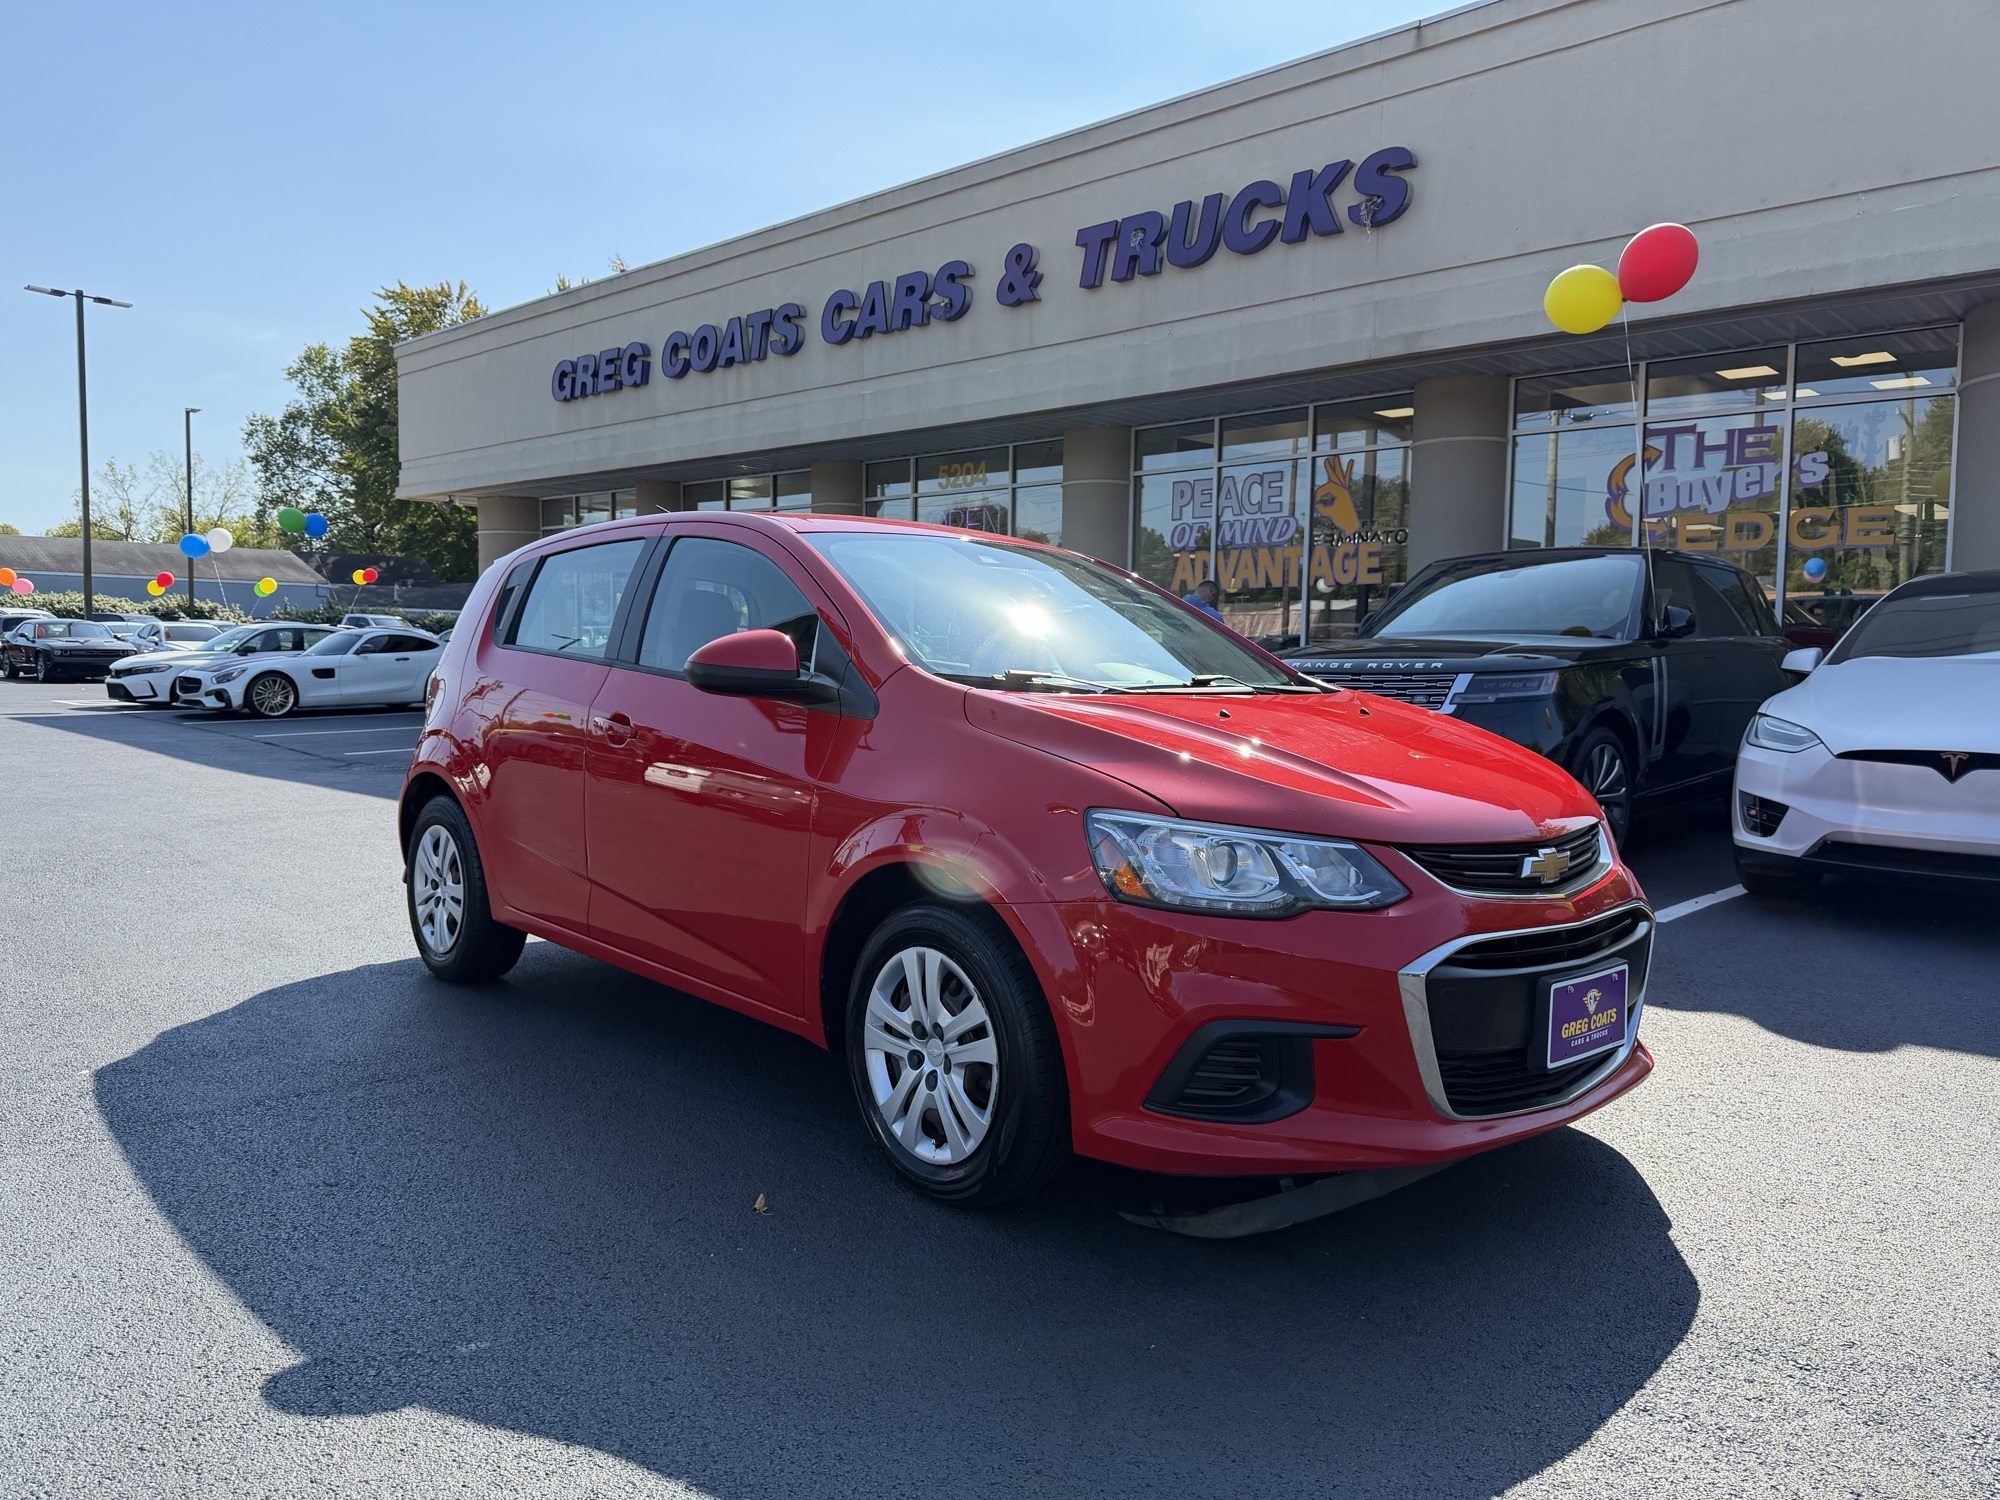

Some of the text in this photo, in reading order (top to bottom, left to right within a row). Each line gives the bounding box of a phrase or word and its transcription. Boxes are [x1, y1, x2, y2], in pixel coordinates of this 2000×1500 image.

[552, 146, 1418, 402] GREG COATS CARS & TRUCKS
[1645, 423, 1778, 473] THE
[937, 460, 988, 491] 5204
[1171, 470, 1284, 521] PEACE
[1171, 515, 1298, 550] OF MIND
[1676, 505, 1896, 552] EDGE
[1170, 541, 1384, 592] ADVANTAGE
[1561, 1008, 1617, 1039] GREG COATS
[1571, 1037, 1585, 1047] CARS
[1591, 1028, 1608, 1041] TRUCKS
